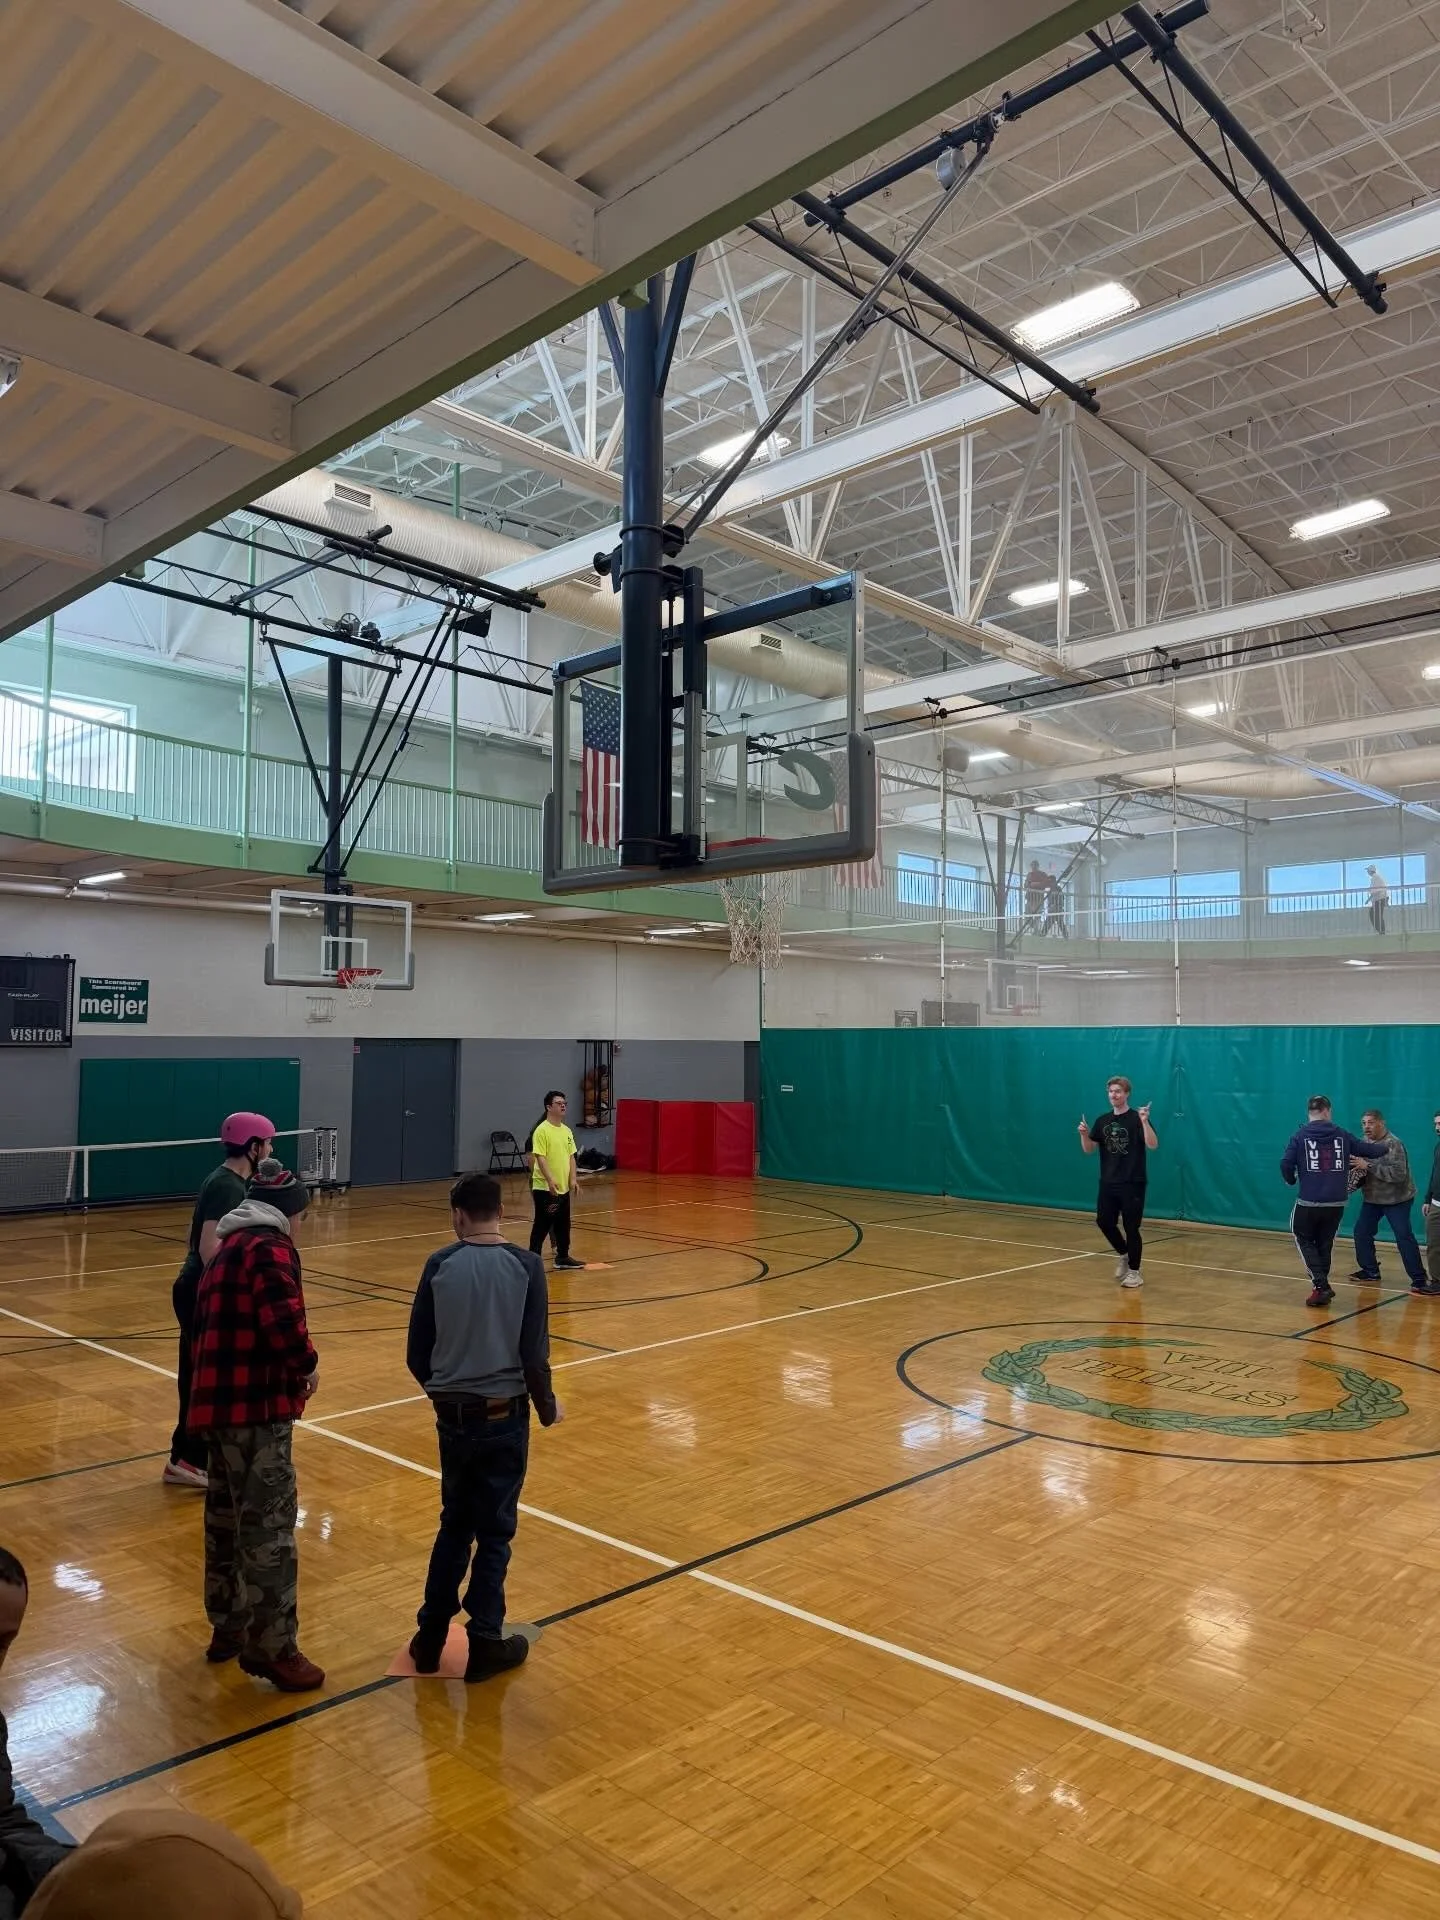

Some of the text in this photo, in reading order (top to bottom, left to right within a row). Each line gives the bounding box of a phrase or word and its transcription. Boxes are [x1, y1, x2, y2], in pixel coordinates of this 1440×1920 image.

[80, 993, 147, 1020] meijer
[10, 1028, 63, 1042] VISITOR
[1163, 1350, 1274, 1379] VII
[1061, 1358, 1300, 1408] HILLS
